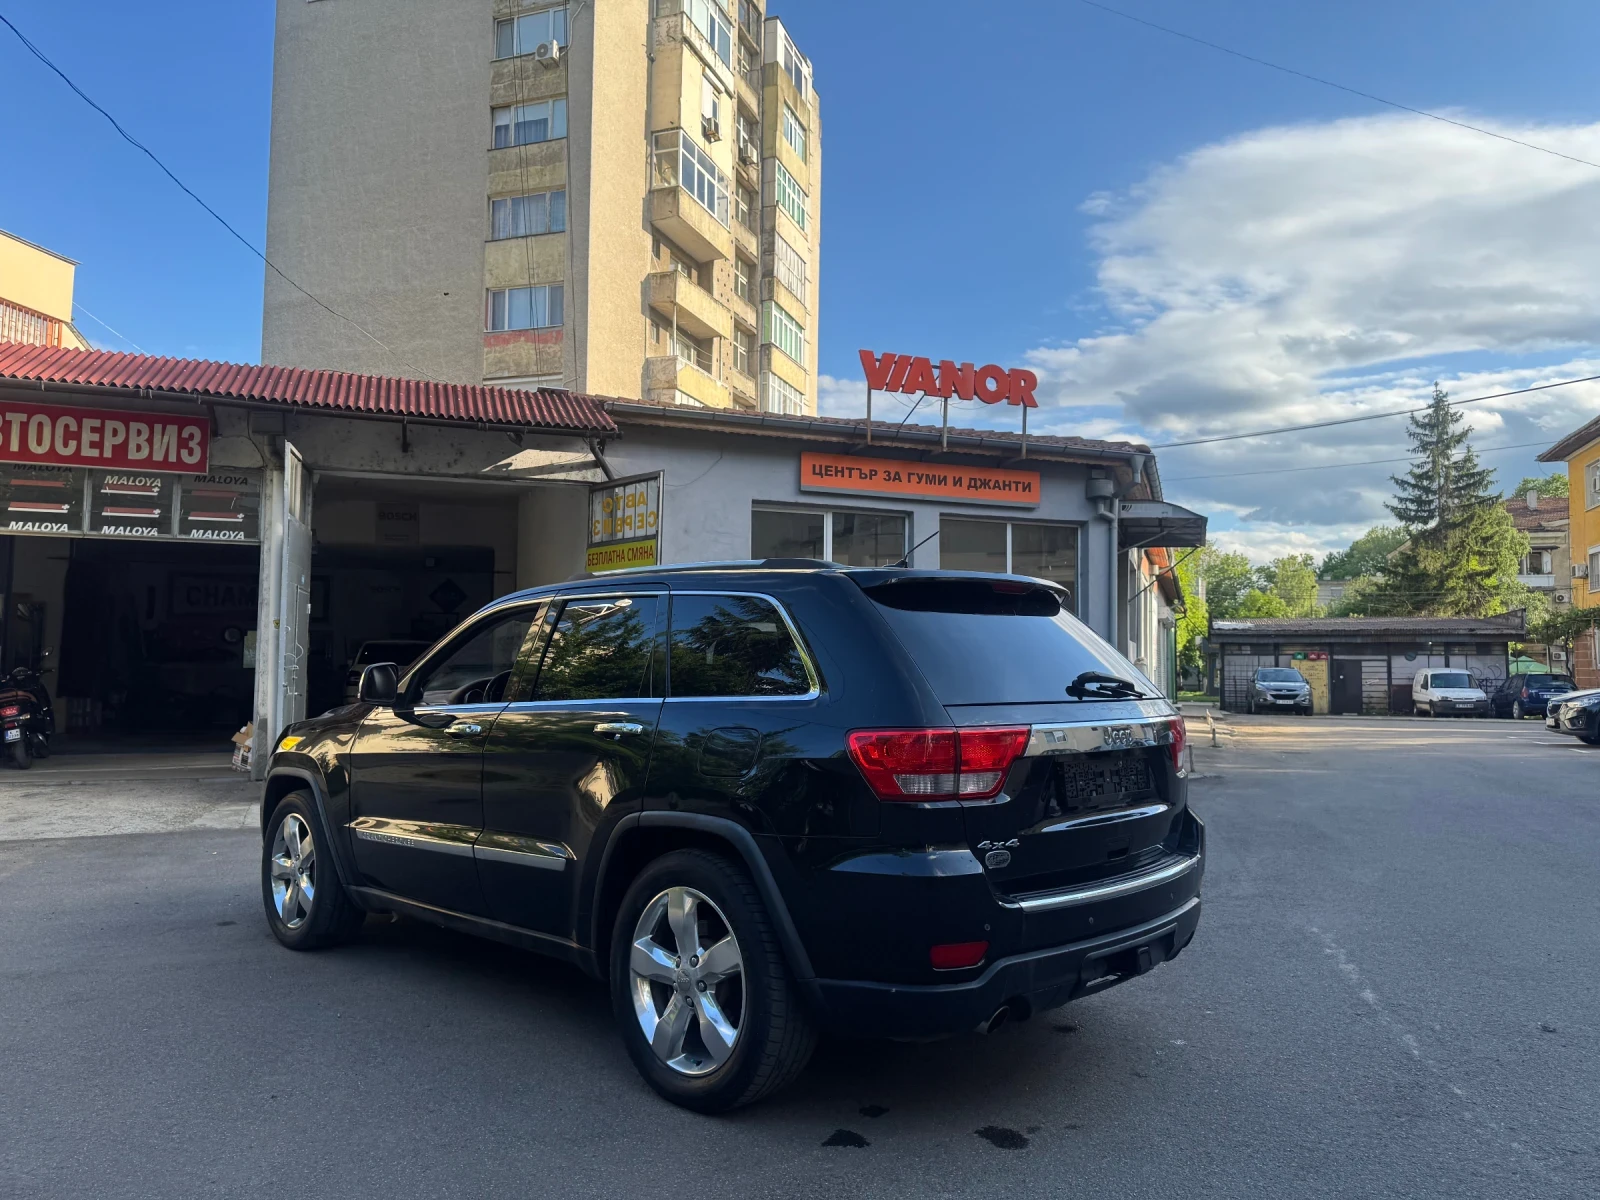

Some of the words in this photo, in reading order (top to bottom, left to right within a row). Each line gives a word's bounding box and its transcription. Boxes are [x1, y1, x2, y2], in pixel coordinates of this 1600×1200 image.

[858, 349, 1039, 408] VIANOR
[104, 475, 162, 487] MALOYA
[194, 475, 249, 486] MALOYA
[811, 463, 878, 481] ЦЕНТЪР
[883, 470, 903, 483] ЗА
[907, 472, 948, 487] ГУМИ
[952, 476, 963, 488] И
[967, 477, 1032, 493] ДЖАНТИ
[8, 520, 69, 533] MALOYA
[101, 525, 158, 537] MALOYA
[190, 529, 245, 540] MALOYA
[587, 549, 625, 567] БЕЗПЛАТНА
[627, 545, 654, 562] СМЯНА
[977, 838, 1020, 850] 4x4
